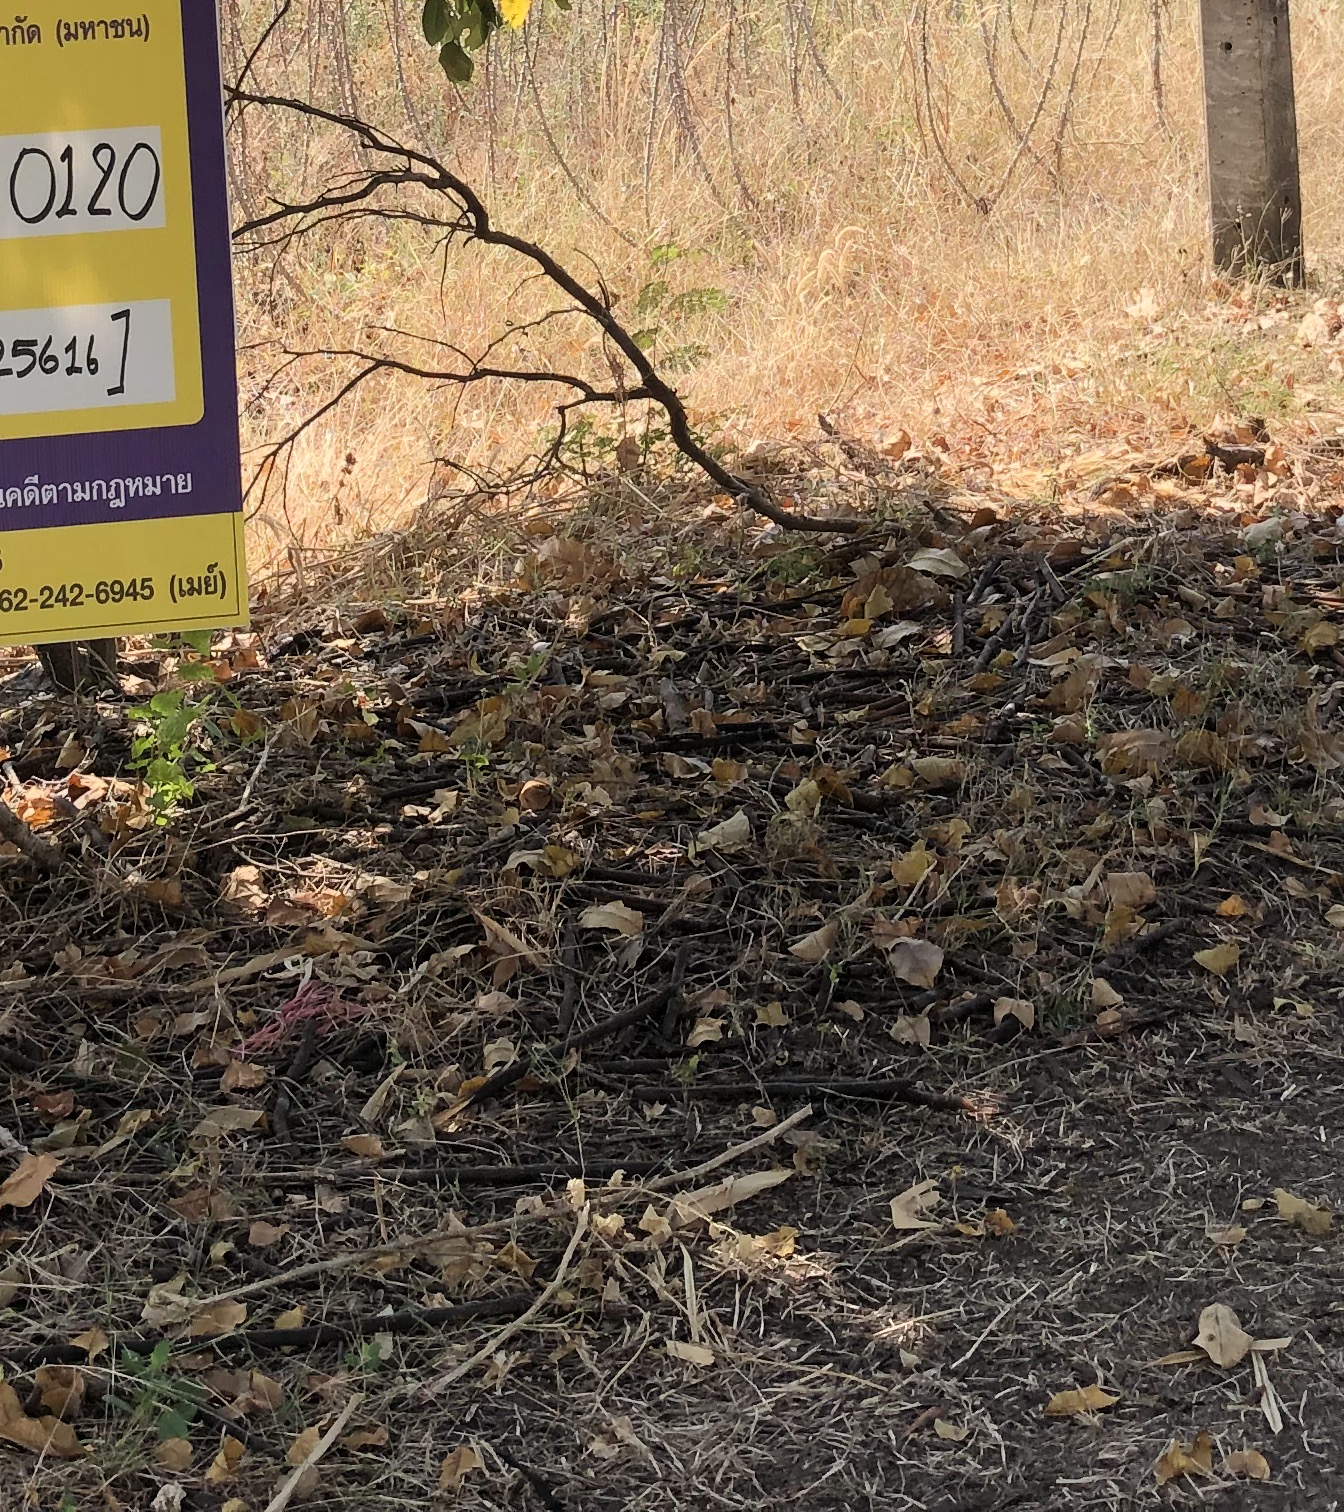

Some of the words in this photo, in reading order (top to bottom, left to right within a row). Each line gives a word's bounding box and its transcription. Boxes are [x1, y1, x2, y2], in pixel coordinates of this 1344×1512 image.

[56, 13, 151, 48] (มหาชน)
[9, 142, 161, 224] 0120
[168, 561, 228, 605] (เมย์)
